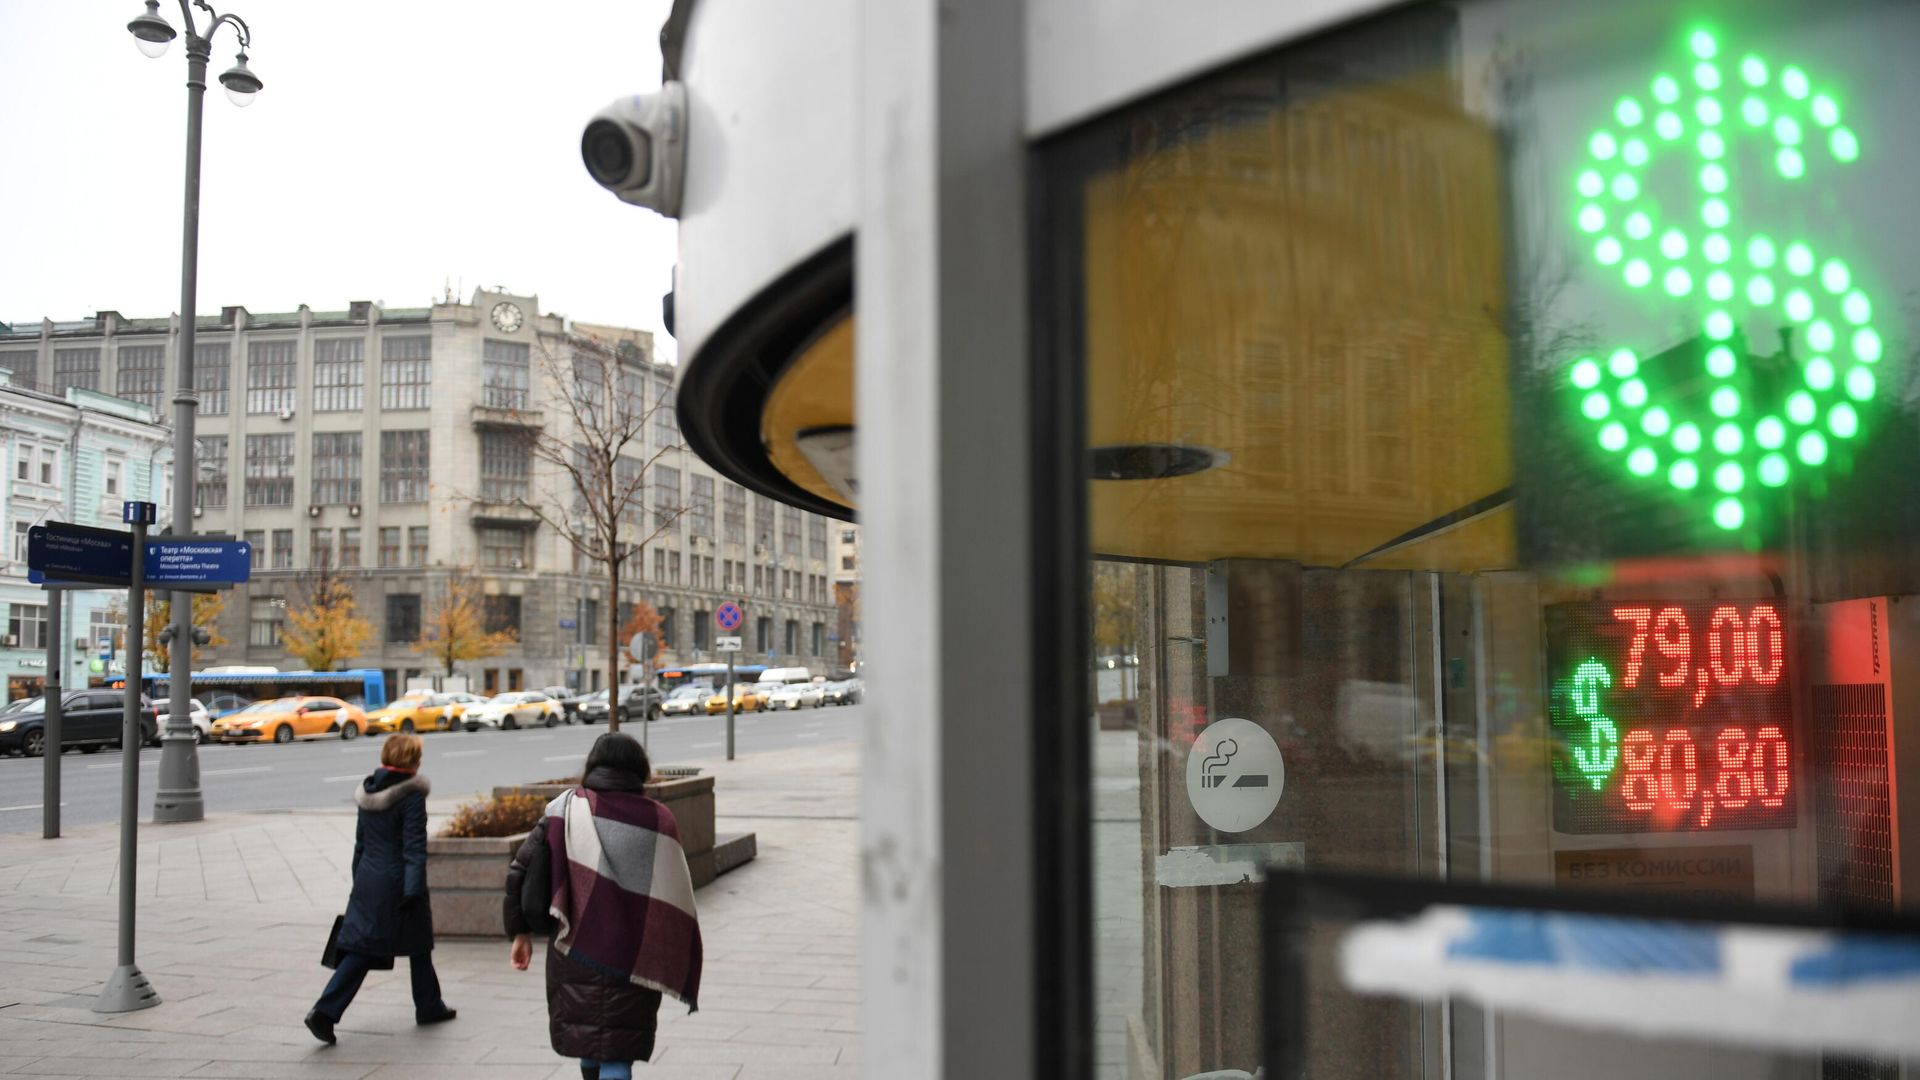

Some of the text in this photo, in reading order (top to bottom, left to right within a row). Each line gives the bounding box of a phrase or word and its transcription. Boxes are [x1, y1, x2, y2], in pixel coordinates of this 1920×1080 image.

[1568, 26, 1884, 532] $
[46, 533, 80, 545] Гостиница
[161, 546, 223, 555] Театр «Московская
[160, 555, 193, 563] оперетта»
[180, 562, 200, 570] Operetta
[201, 562, 220, 570] Theatre
[1613, 605, 1783, 708] 79,00
[1571, 655, 1618, 791] $
[1621, 726, 1789, 828] 80,80
[1569, 857, 1742, 880] БЕЗ КОМИССИИ
